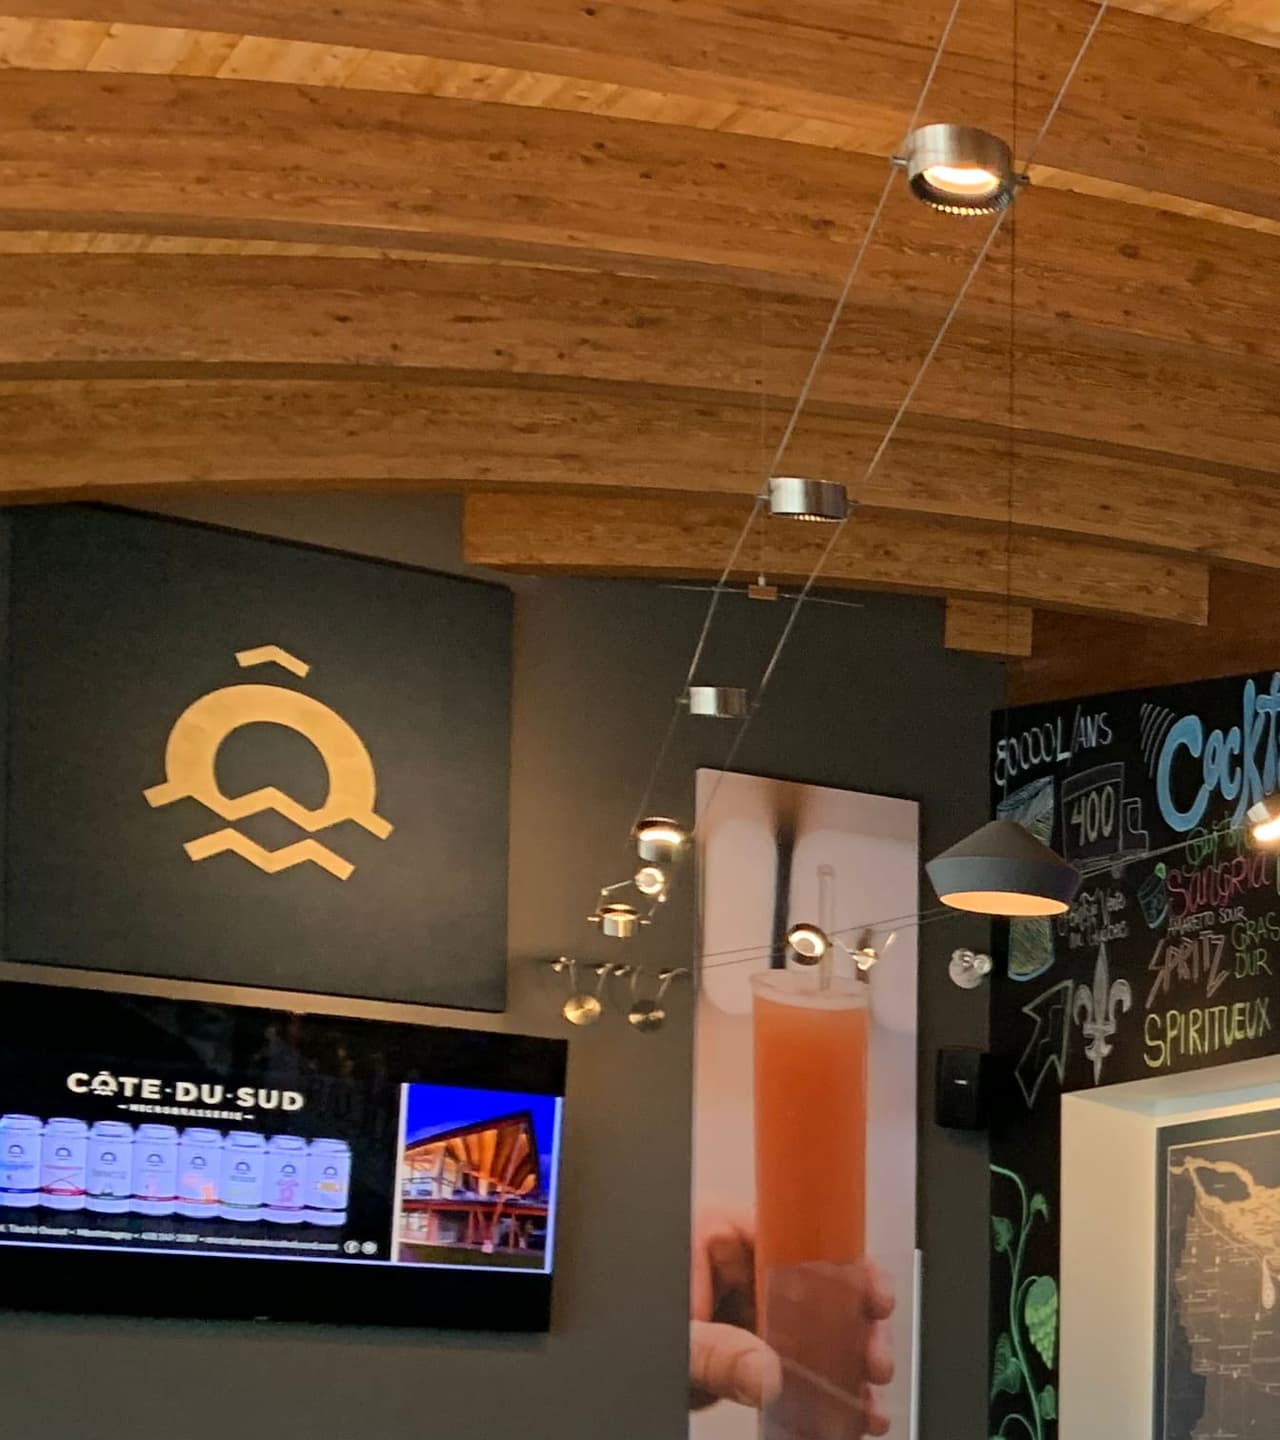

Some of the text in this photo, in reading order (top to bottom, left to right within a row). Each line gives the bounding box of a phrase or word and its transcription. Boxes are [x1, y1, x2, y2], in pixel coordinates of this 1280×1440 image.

[1070, 784, 1116, 847] 400
[1143, 996, 1273, 1069] SPIRITUEUX
[66, 1070, 304, 1111] CÔTE DU SUD
